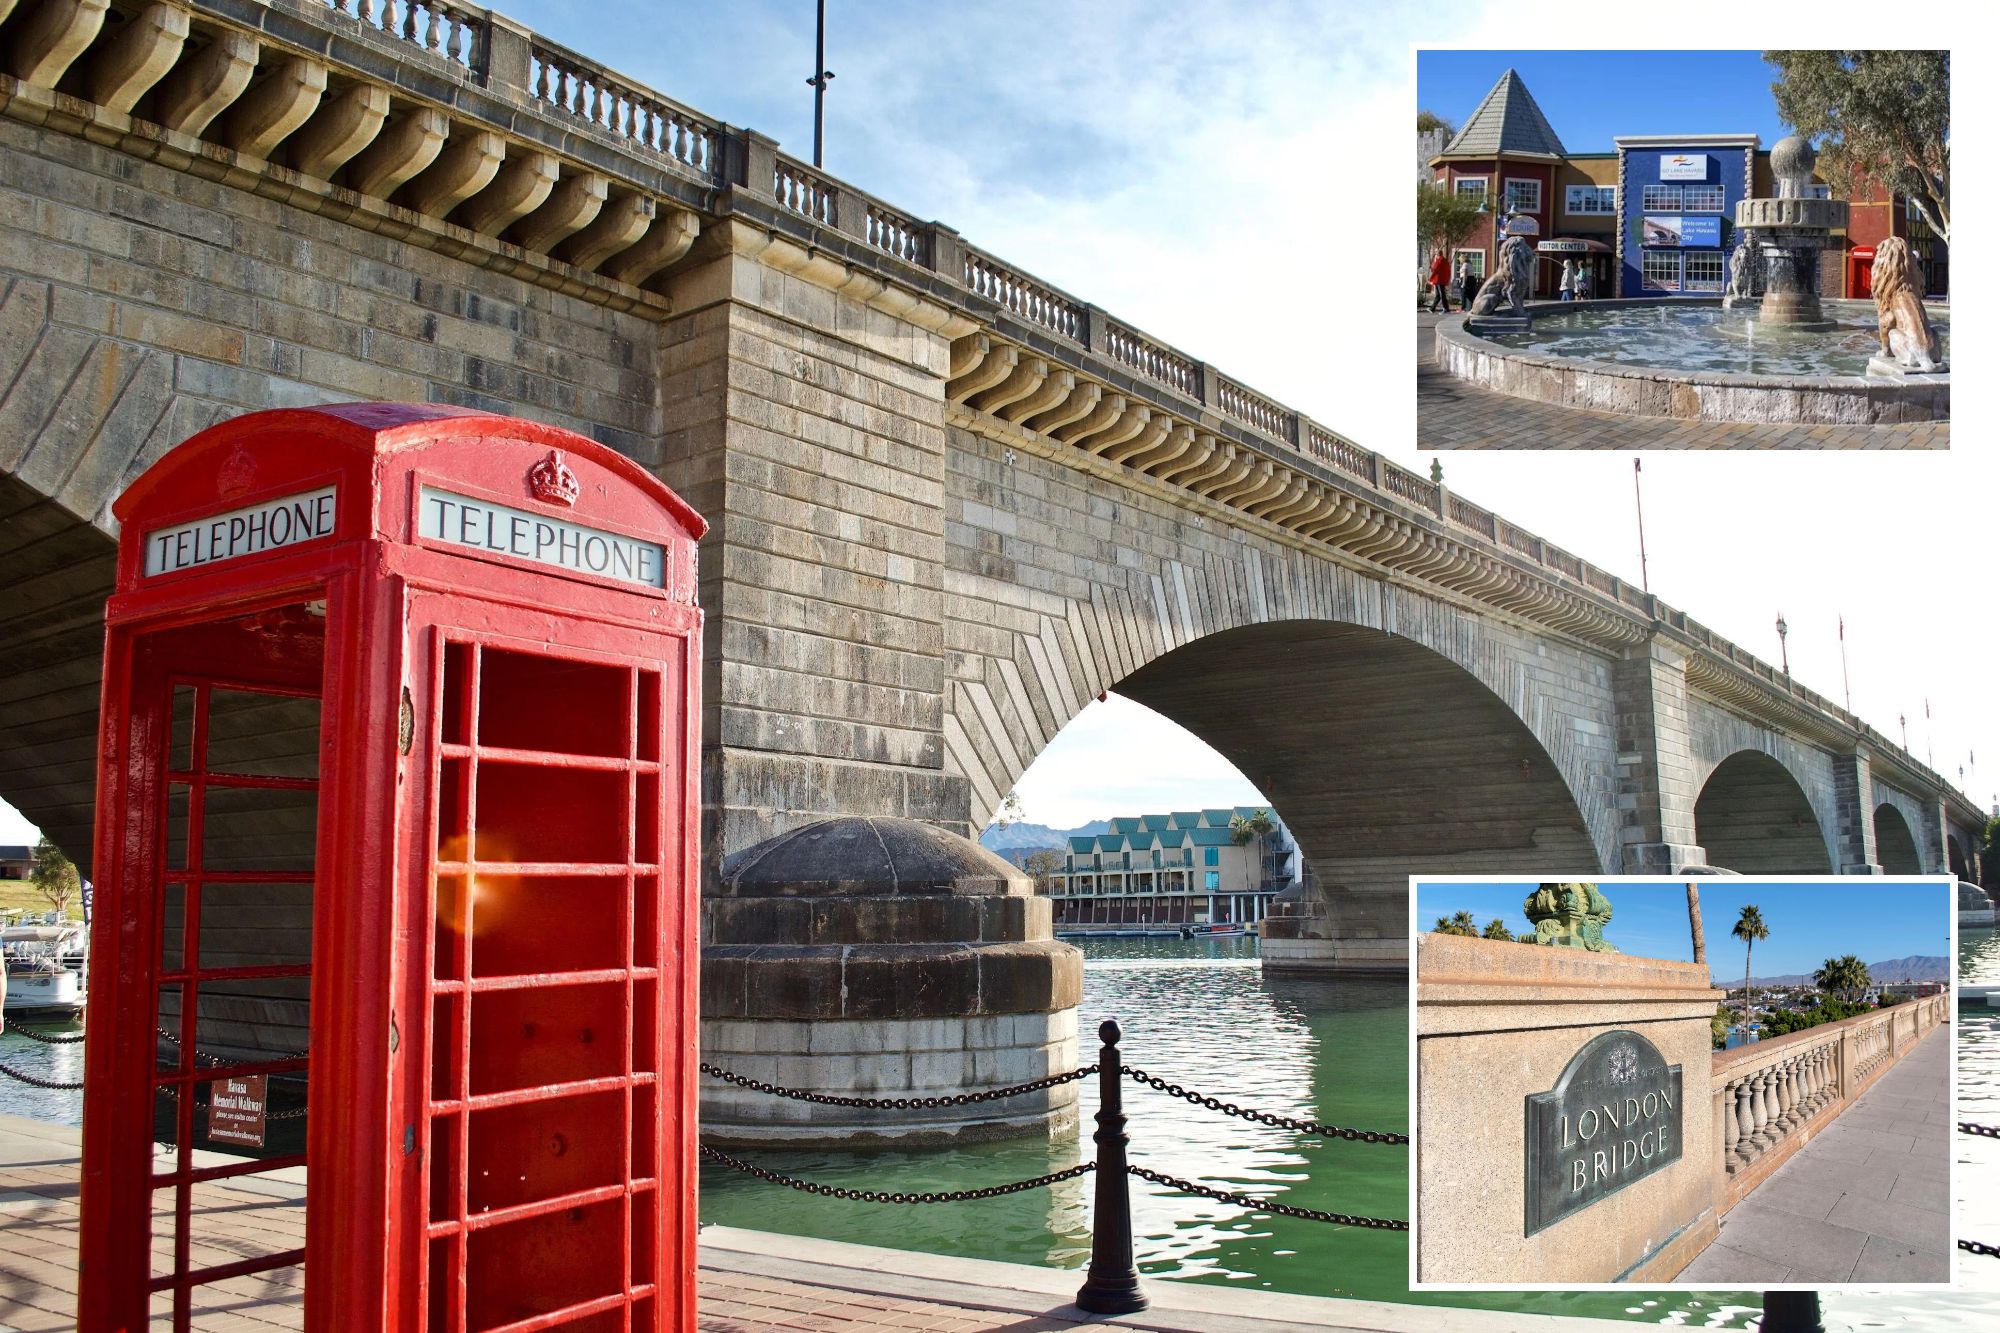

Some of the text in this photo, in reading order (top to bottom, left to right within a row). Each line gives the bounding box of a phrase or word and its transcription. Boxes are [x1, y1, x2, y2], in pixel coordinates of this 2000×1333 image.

[1561, 242, 1585, 250] CENTER
[158, 494, 333, 571] TELEPHONE
[430, 498, 654, 582] TELEPHONE
[213, 1093, 262, 1112] Memorial Walkway
[1561, 1087, 1673, 1149] LONDON
[1572, 1125, 1668, 1193] BRIDGE
